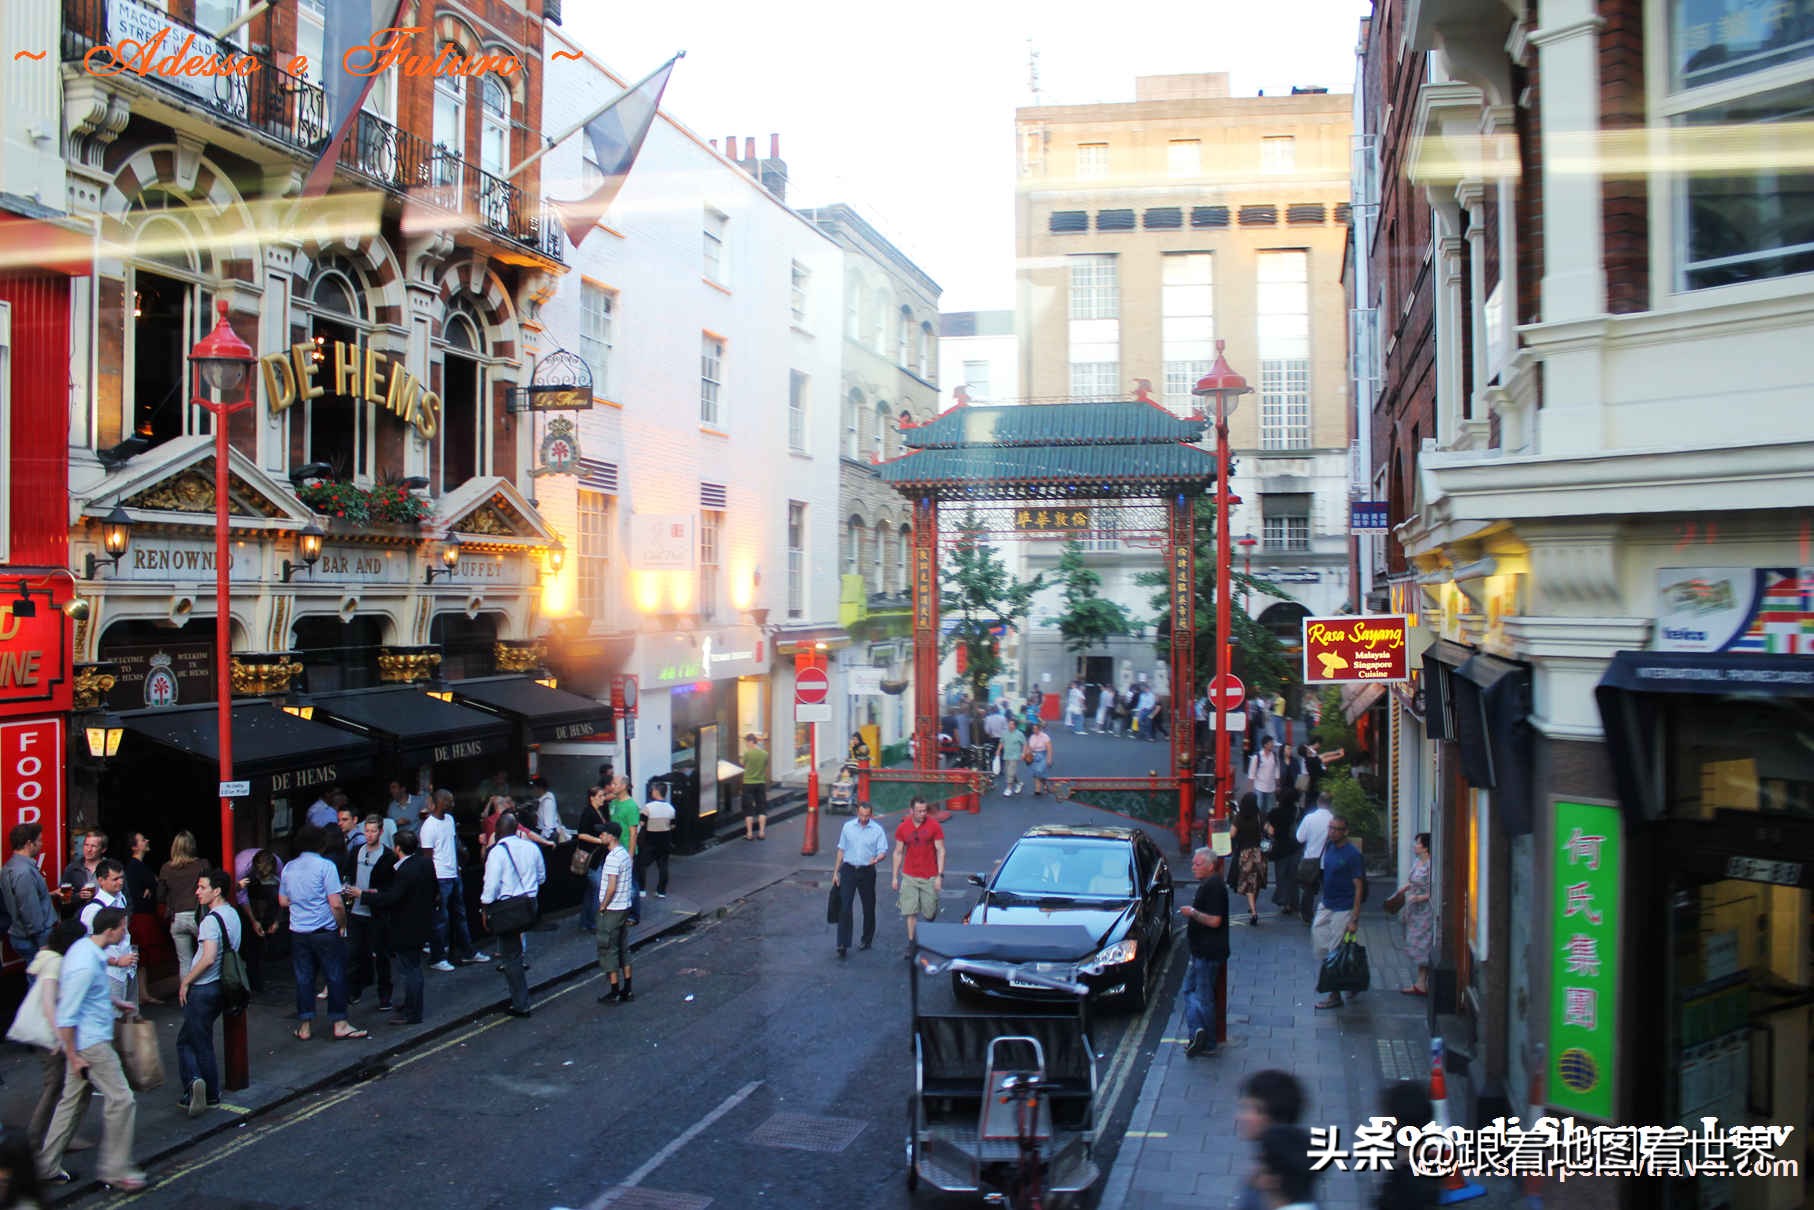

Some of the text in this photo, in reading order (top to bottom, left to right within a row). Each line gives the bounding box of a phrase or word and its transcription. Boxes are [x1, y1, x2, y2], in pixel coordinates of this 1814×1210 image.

[119, 4, 212, 55] MACCLSFELD
[119, 20, 167, 51] STRET
[261, 340, 441, 440] DE HEMS
[322, 556, 382, 575] BAR AND
[1308, 623, 1345, 646] Rasa
[1353, 661, 1393, 671] Singapore
[1355, 651, 1391, 661] Malaysia
[0, 650, 42, 687] INE
[1358, 670, 1388, 679] Cuisine
[556, 721, 594, 739] DE HEMS
[434, 740, 482, 763] DE HEMS
[17, 732, 43, 826] FOOD
[271, 773, 291, 792] DE
[296, 764, 337, 787] HEMS
